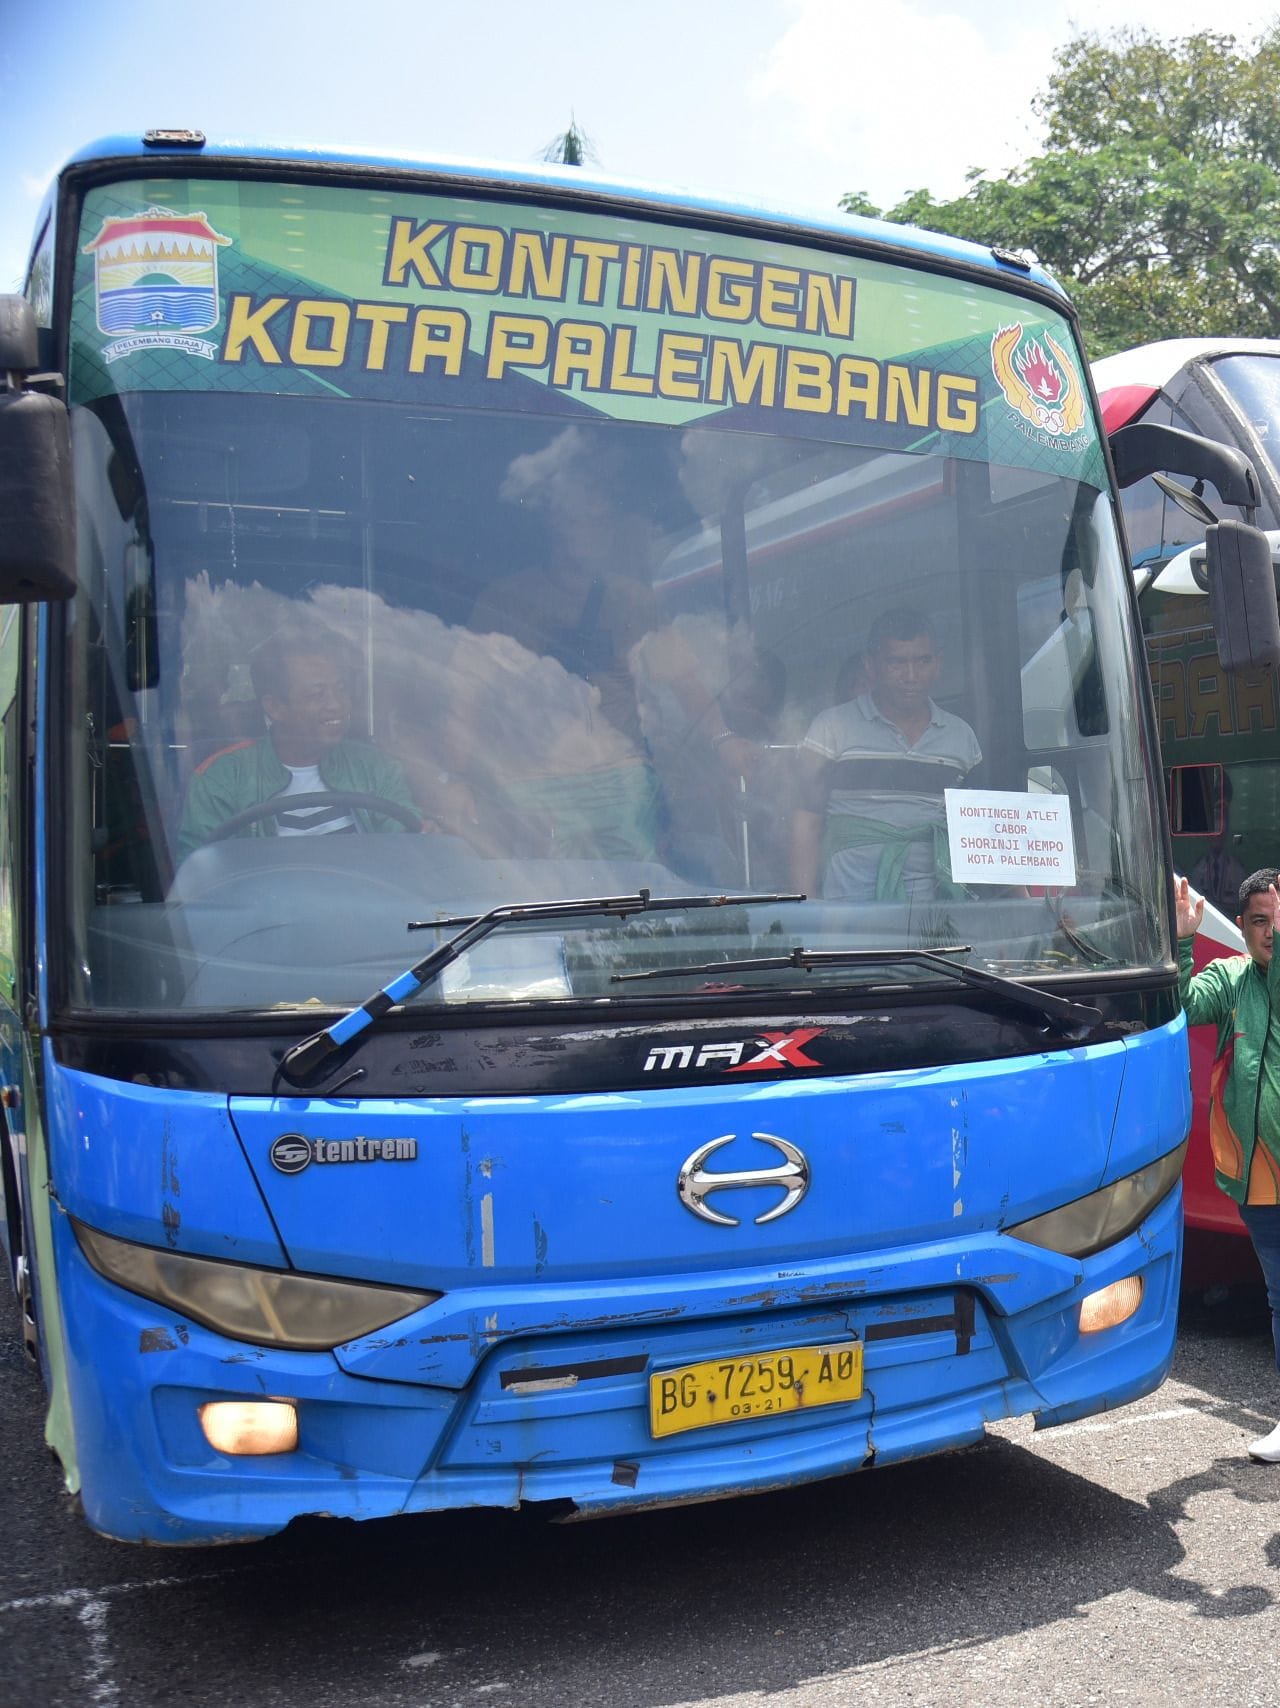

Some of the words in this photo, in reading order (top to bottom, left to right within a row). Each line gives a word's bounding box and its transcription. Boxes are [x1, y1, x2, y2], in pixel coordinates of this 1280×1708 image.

[384, 217, 855, 339] KONTINGEN
[221, 295, 470, 378] KOTA
[486, 312, 980, 435] PALEMBANG
[1007, 411, 1089, 453] PALEMBANG
[959, 806, 1020, 820] KONTINGEN
[1026, 810, 1059, 821] ATLET
[994, 823, 1028, 835] CABOR
[960, 837, 1020, 851] SHORINJI
[1027, 840, 1064, 852] KEMPO
[967, 853, 995, 865] KOTA
[1000, 855, 1060, 867] PALEMBANG
[643, 1028, 829, 1072] MAX
[314, 1136, 417, 1163] tentrem
[661, 1372, 697, 1415] BG
[718, 1356, 795, 1400] 7259
